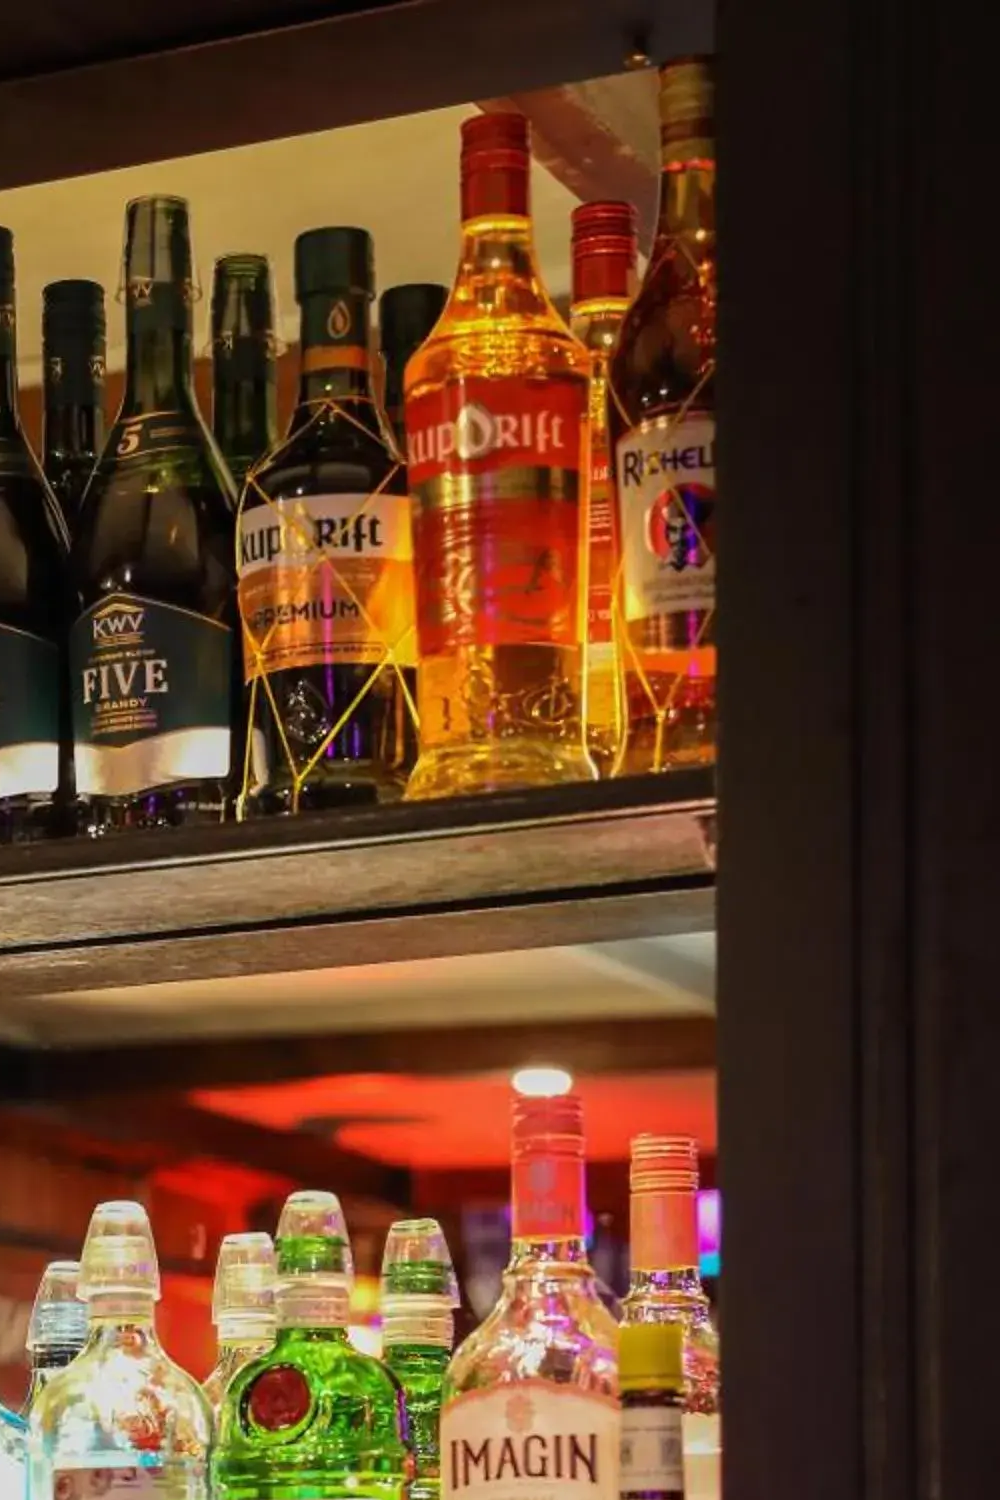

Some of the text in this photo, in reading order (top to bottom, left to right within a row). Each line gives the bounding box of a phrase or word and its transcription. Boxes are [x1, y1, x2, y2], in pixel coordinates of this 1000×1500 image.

[117, 425, 143, 455] 5
[93, 613, 144, 640] KWV
[83, 659, 169, 705] FIVE
[451, 1432, 599, 1490] IMAGIN
